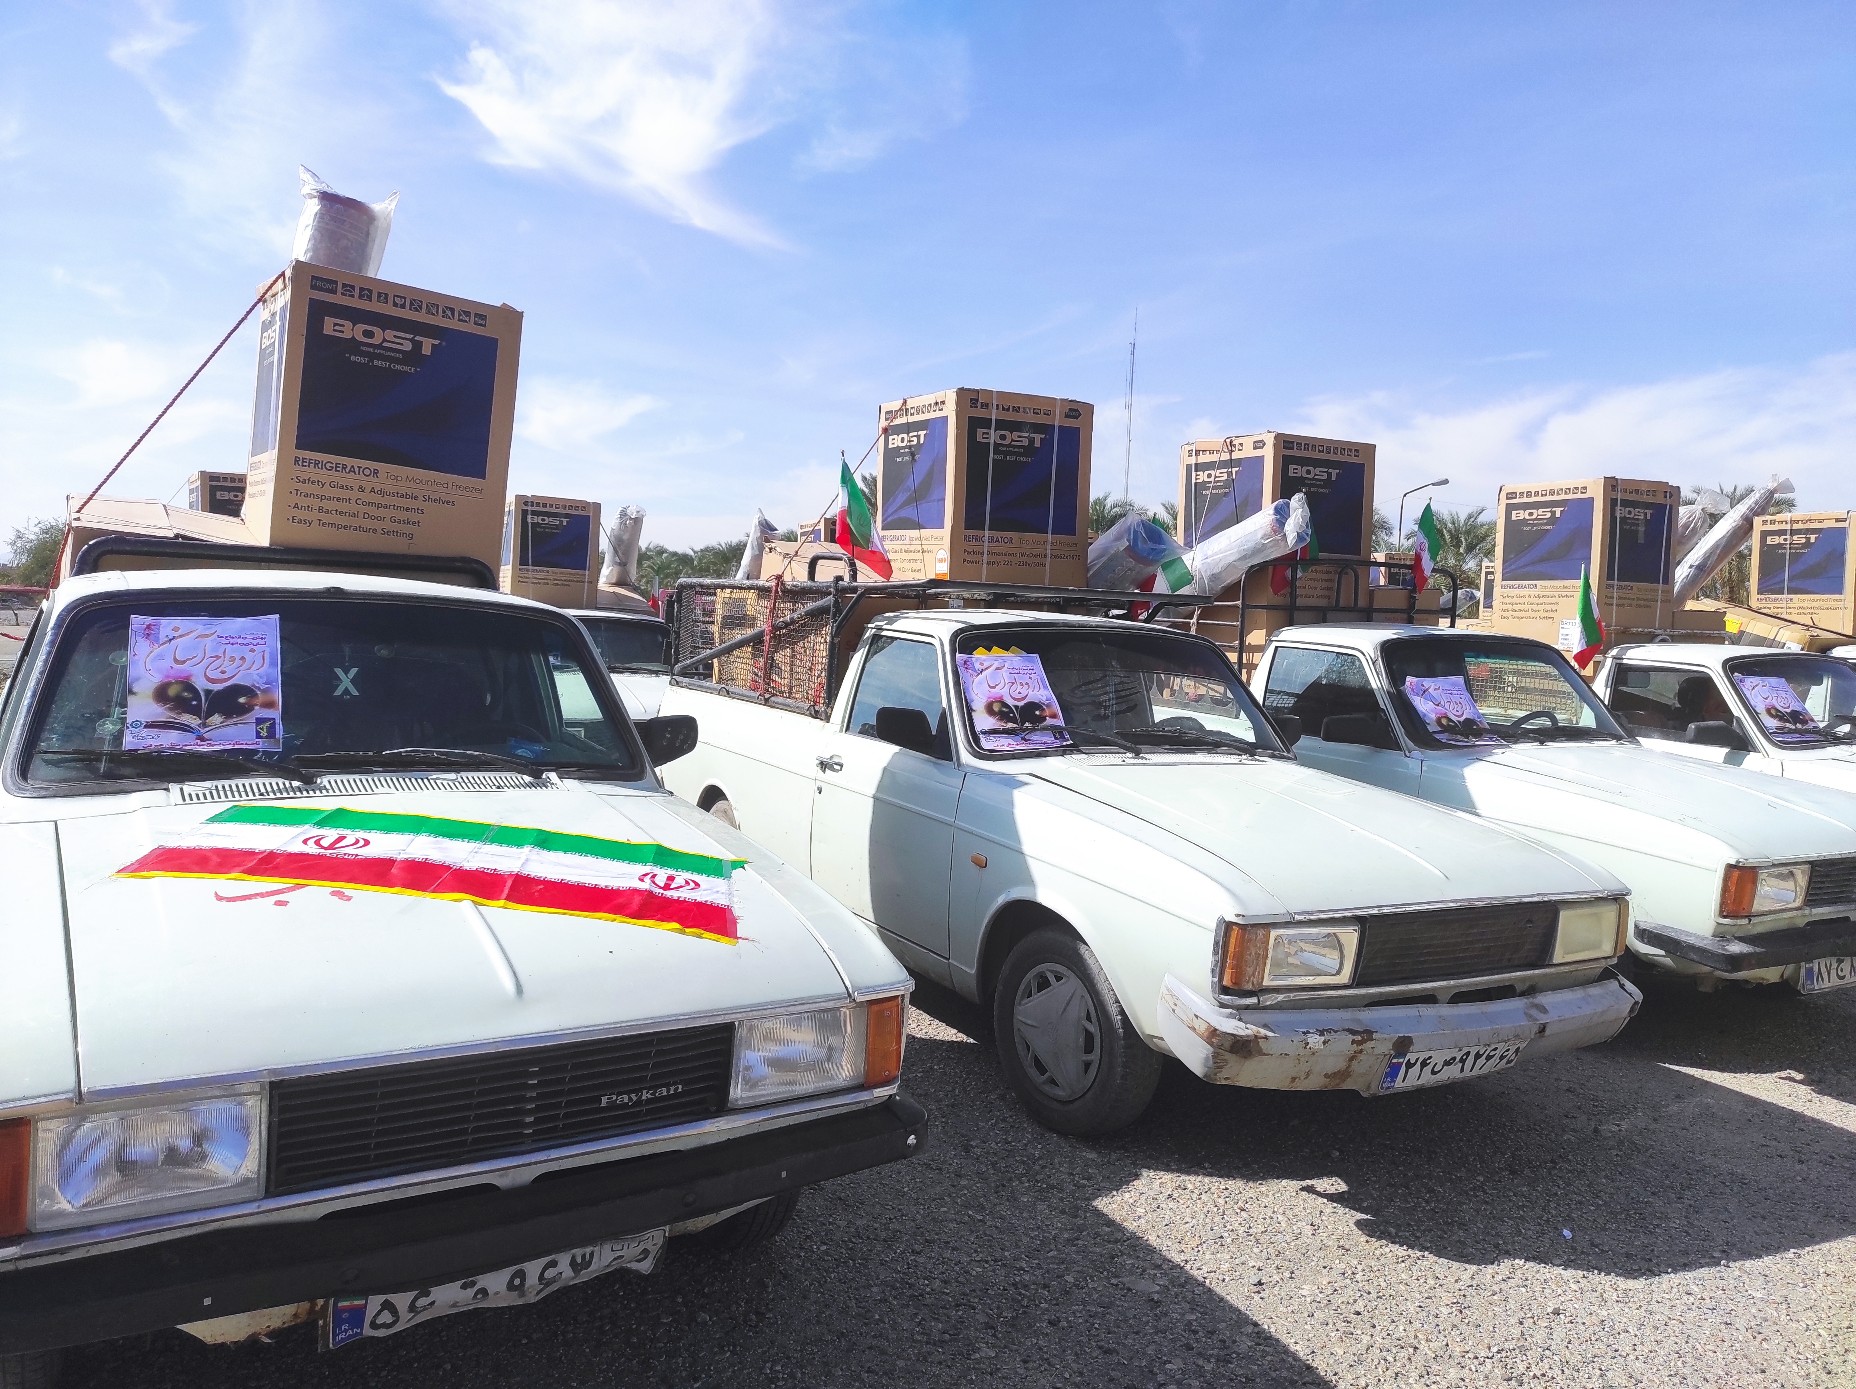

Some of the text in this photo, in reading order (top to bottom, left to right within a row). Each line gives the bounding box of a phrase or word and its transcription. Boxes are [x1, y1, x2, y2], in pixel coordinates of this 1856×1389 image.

[312, 279, 337, 290] FRONT
[322, 316, 441, 356] BOST
[373, 359, 390, 369] BEST
[889, 430, 927, 448] BOST
[976, 428, 1045, 448] BOST
[293, 455, 484, 495] REFRIGERATOR Top Mounted Freezer
[1288, 464, 1340, 481] BOST
[295, 476, 456, 507] Safety Glass & Adjustable Shelves
[294, 489, 425, 515] Transparent Compartments
[293, 502, 421, 528] Anti-Bacterial Door Gasket
[527, 515, 569, 526] BOST
[1511, 507, 1565, 520] BOST
[1615, 507, 1652, 520] BOST
[291, 515, 414, 541] Easy Temperature Setting
[204, 647, 266, 685] ازدواج
[600, 1084, 683, 1107] Paykan
[335, 1328, 360, 1341] IRAN
